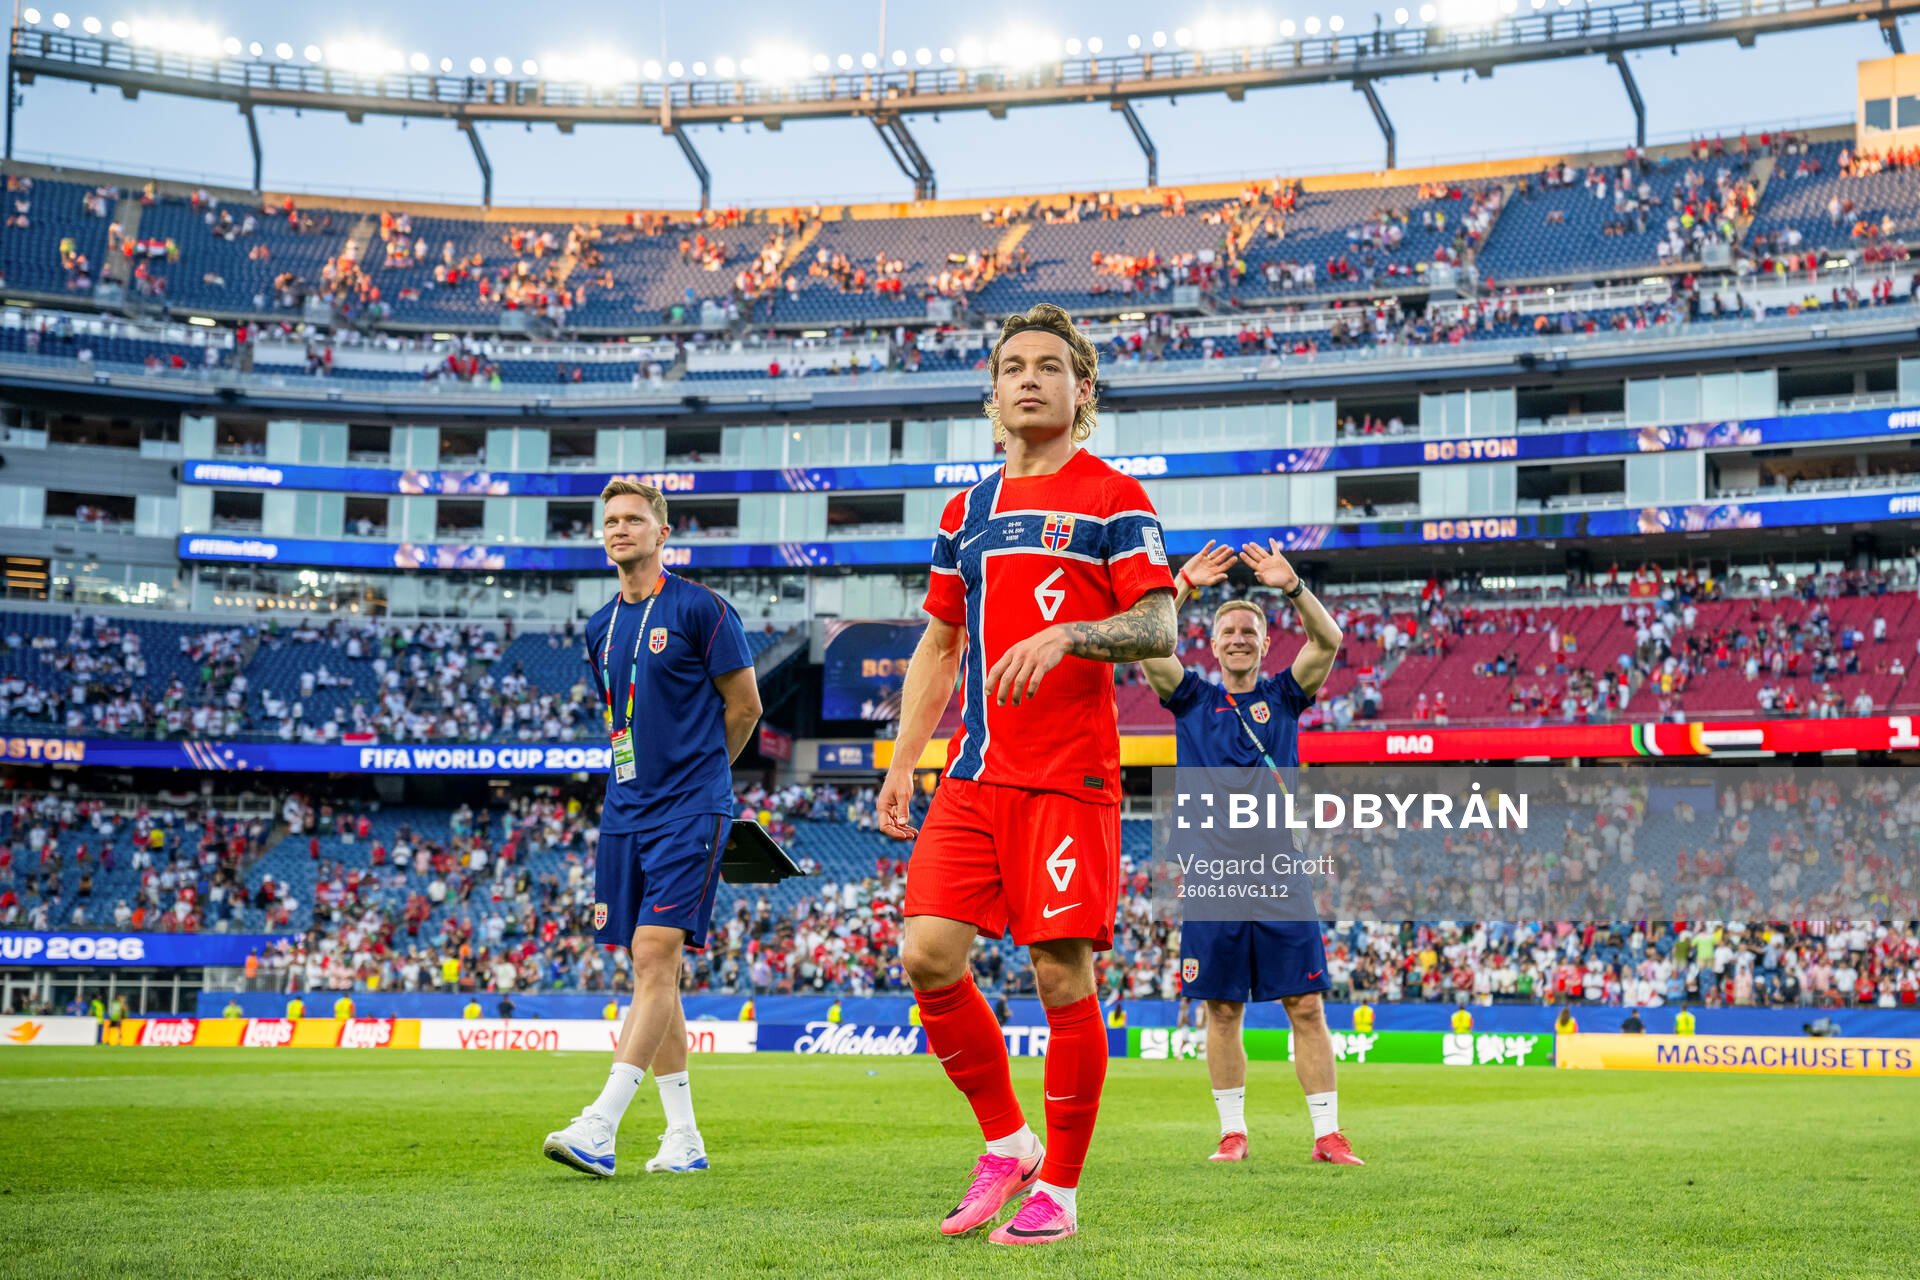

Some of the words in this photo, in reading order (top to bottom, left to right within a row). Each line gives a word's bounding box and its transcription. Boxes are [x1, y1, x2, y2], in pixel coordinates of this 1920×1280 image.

[1424, 438, 1518, 461] BOSTON
[934, 464, 979, 483] FIFA
[1103, 456, 1168, 475] 026
[1423, 519, 1517, 540] BOSTON
[1034, 567, 1066, 621] 6
[861, 659, 909, 677] BOS
[1889, 716, 1919, 747] 1
[1386, 735, 1434, 754] IRAQ
[360, 749, 411, 768] FIFA
[413, 749, 495, 769] WORLD
[497, 748, 543, 769] CUP
[1046, 835, 1076, 892] 6
[0, 936, 43, 959] UP
[46, 937, 144, 960] 2026
[458, 1020, 558, 1050] verizon
[794, 1021, 920, 1055] Michelob
[1657, 1044, 1913, 1069] MASSACHUSETTS
